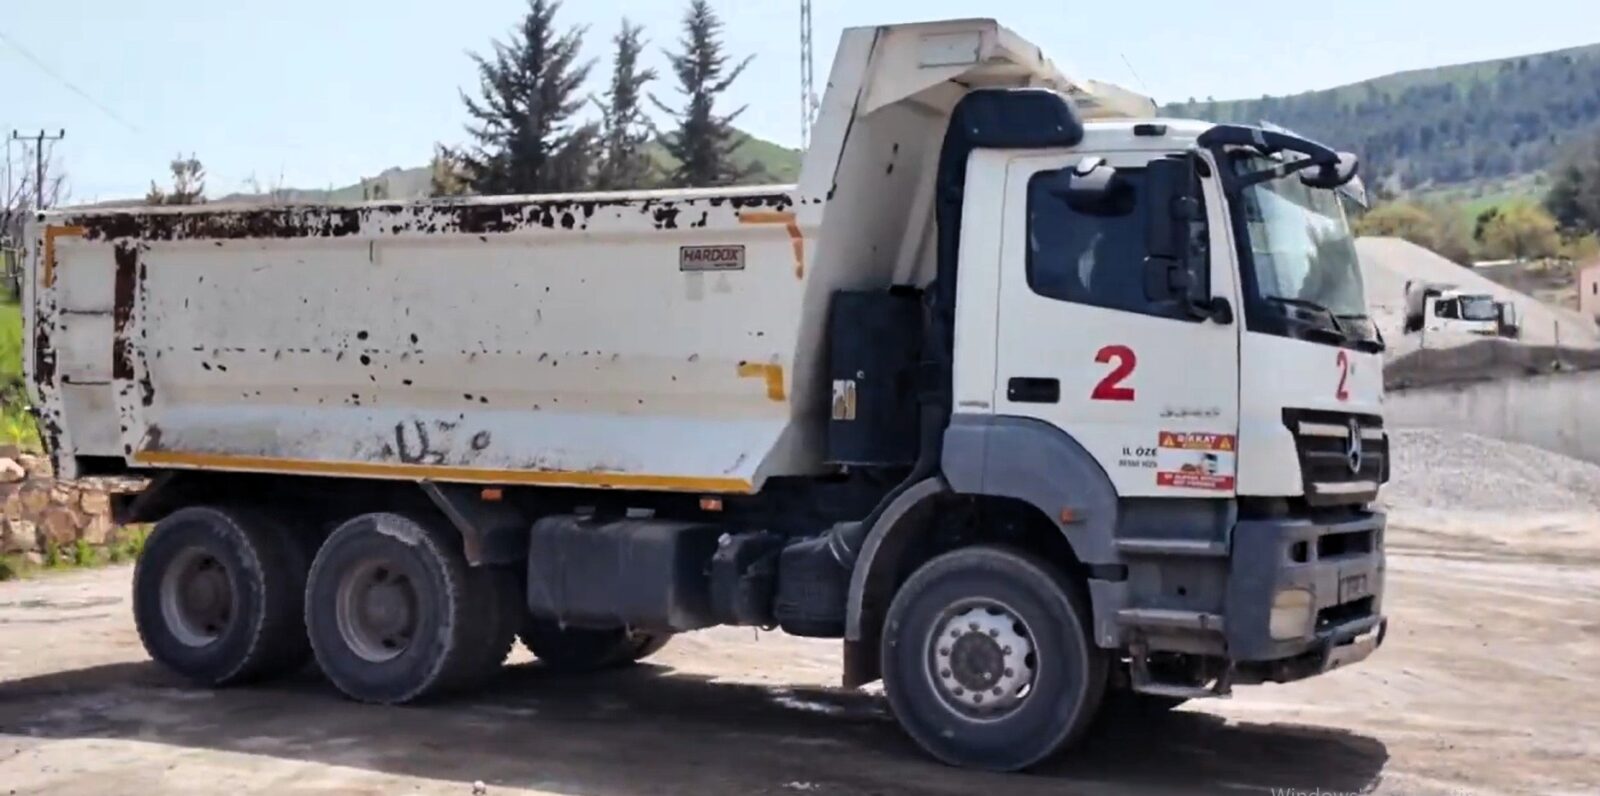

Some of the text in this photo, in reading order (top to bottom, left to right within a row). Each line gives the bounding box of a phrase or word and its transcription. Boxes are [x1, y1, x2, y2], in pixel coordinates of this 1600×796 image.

[683, 248, 738, 262] HARDOX
[1091, 345, 1136, 402] 2
[1335, 350, 1349, 401] 2
